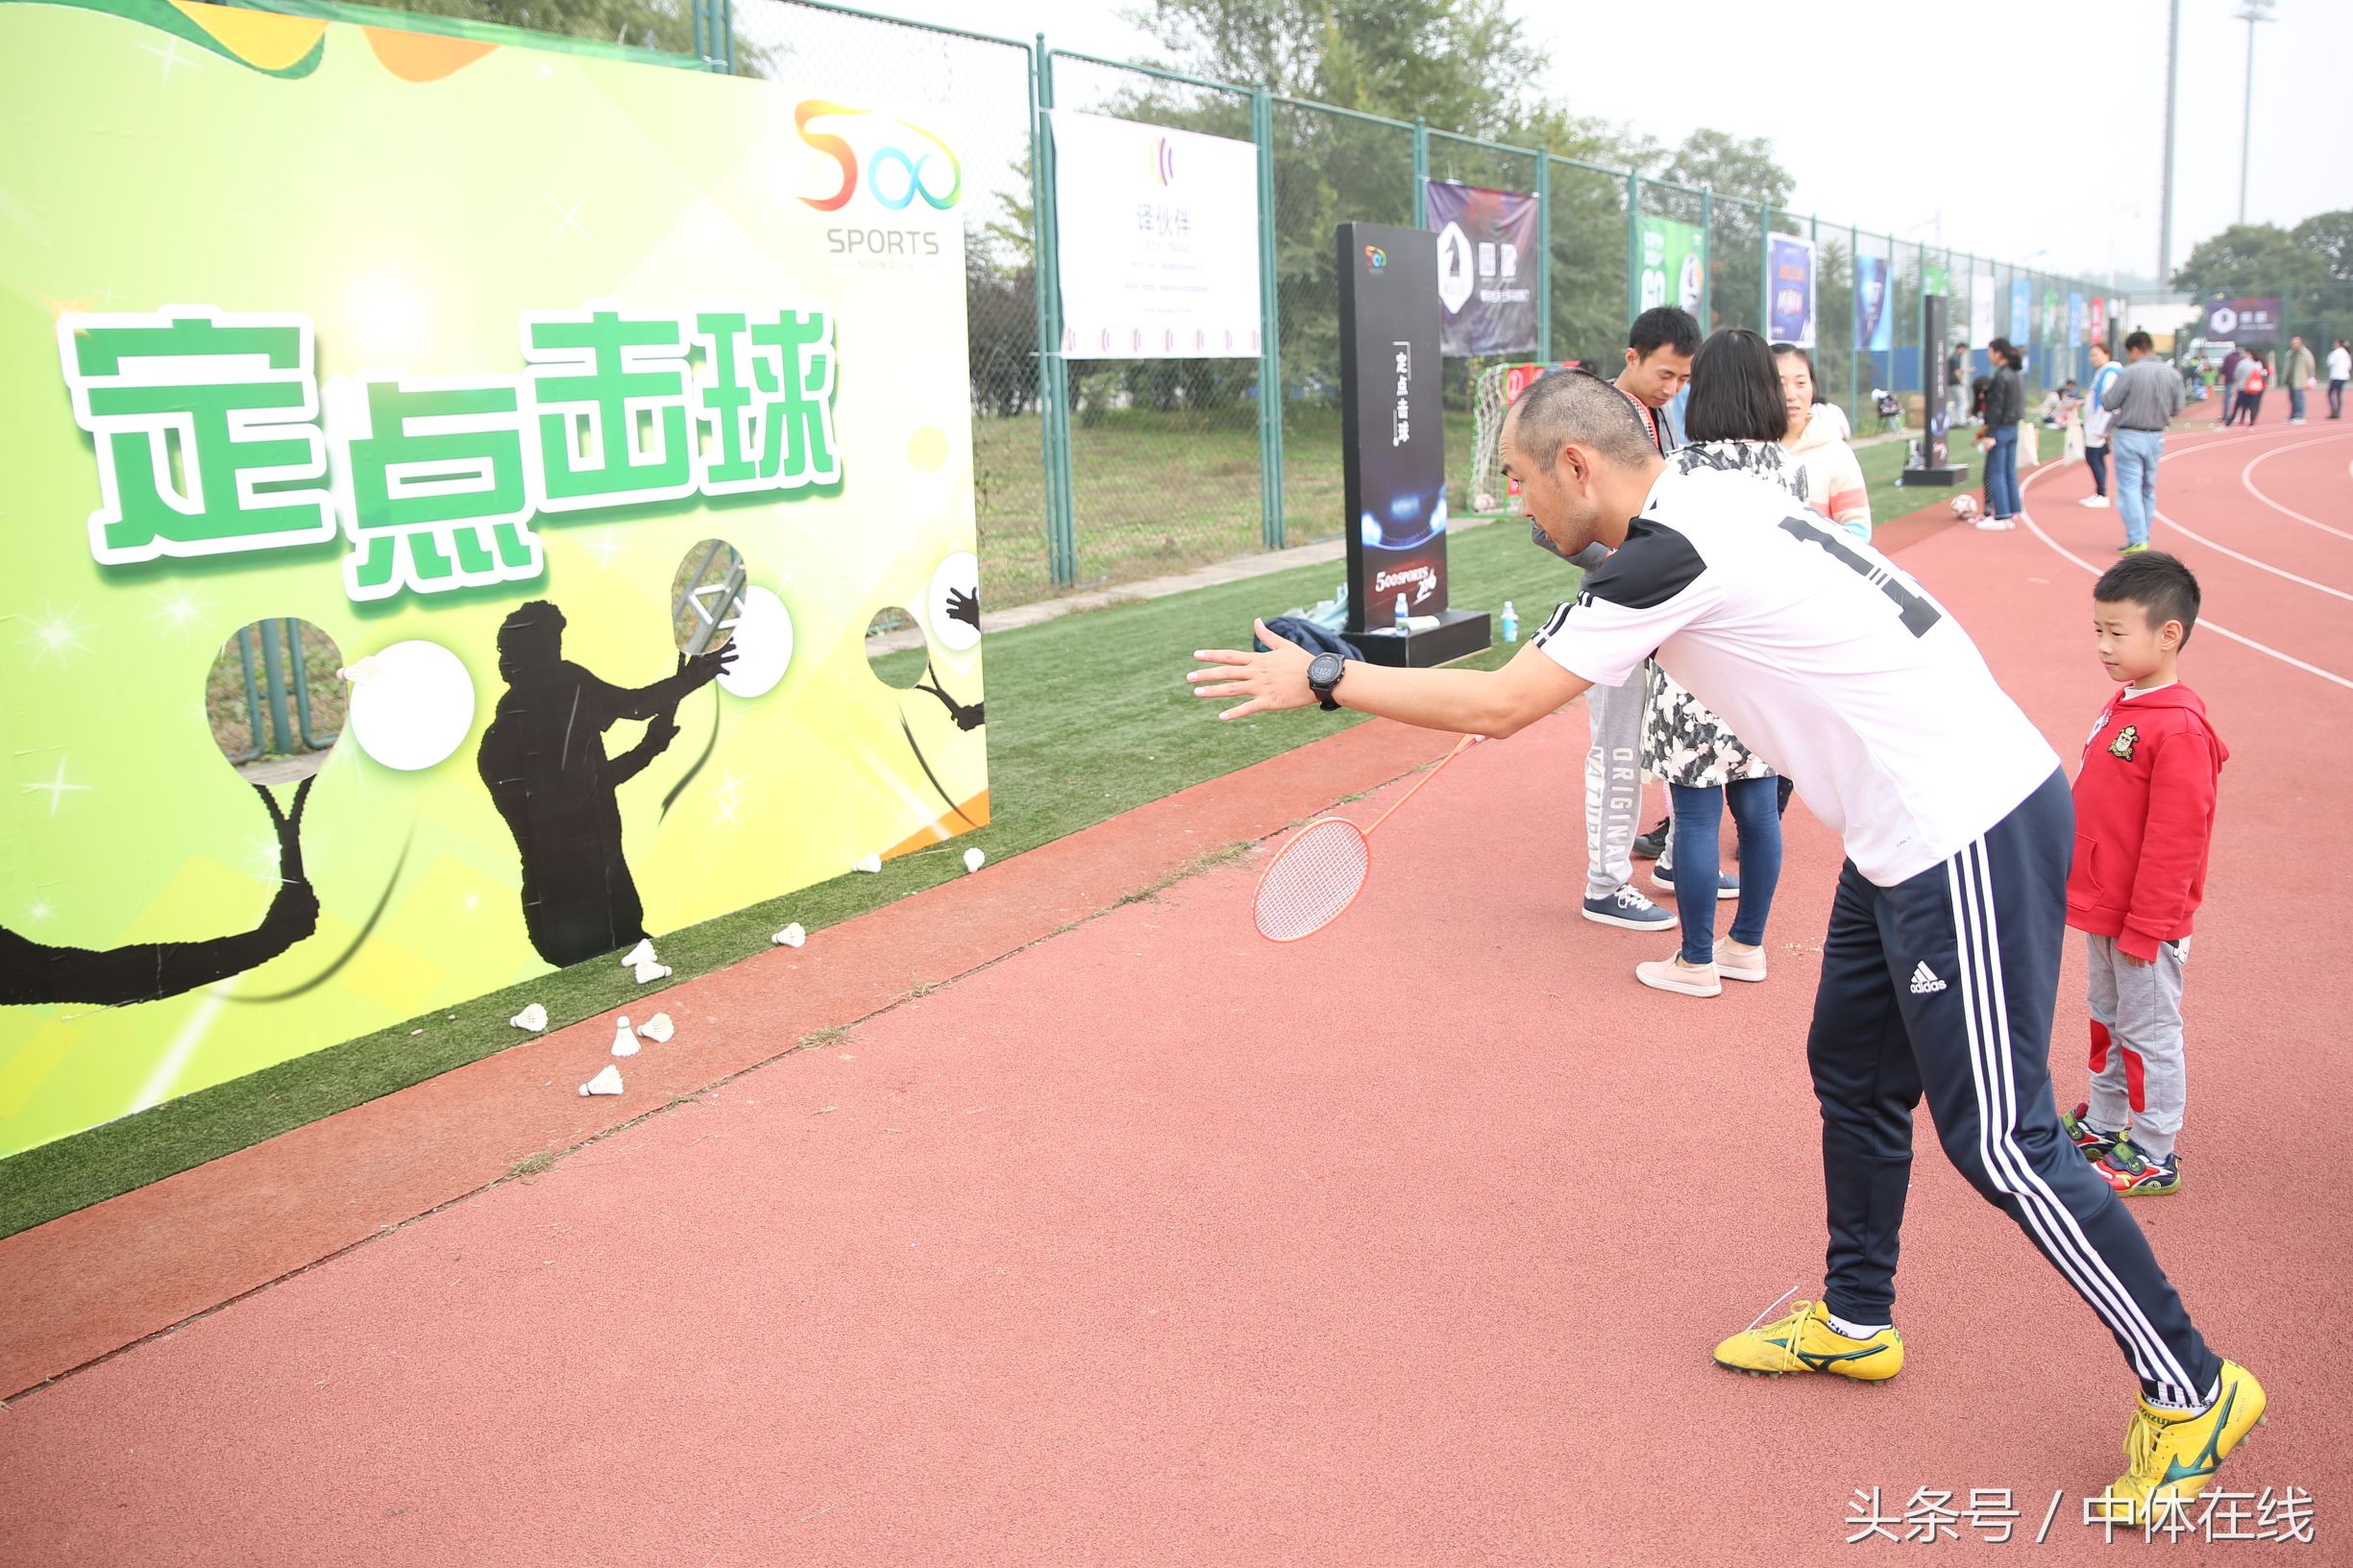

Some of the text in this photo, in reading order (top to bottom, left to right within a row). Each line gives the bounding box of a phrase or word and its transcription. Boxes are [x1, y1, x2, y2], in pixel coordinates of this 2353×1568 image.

[826, 228, 940, 256] SPORTS
[63, 306, 841, 600] 定点击球
[1605, 747, 1634, 873] ORIGINAL
[1910, 980, 1947, 993] adidas
